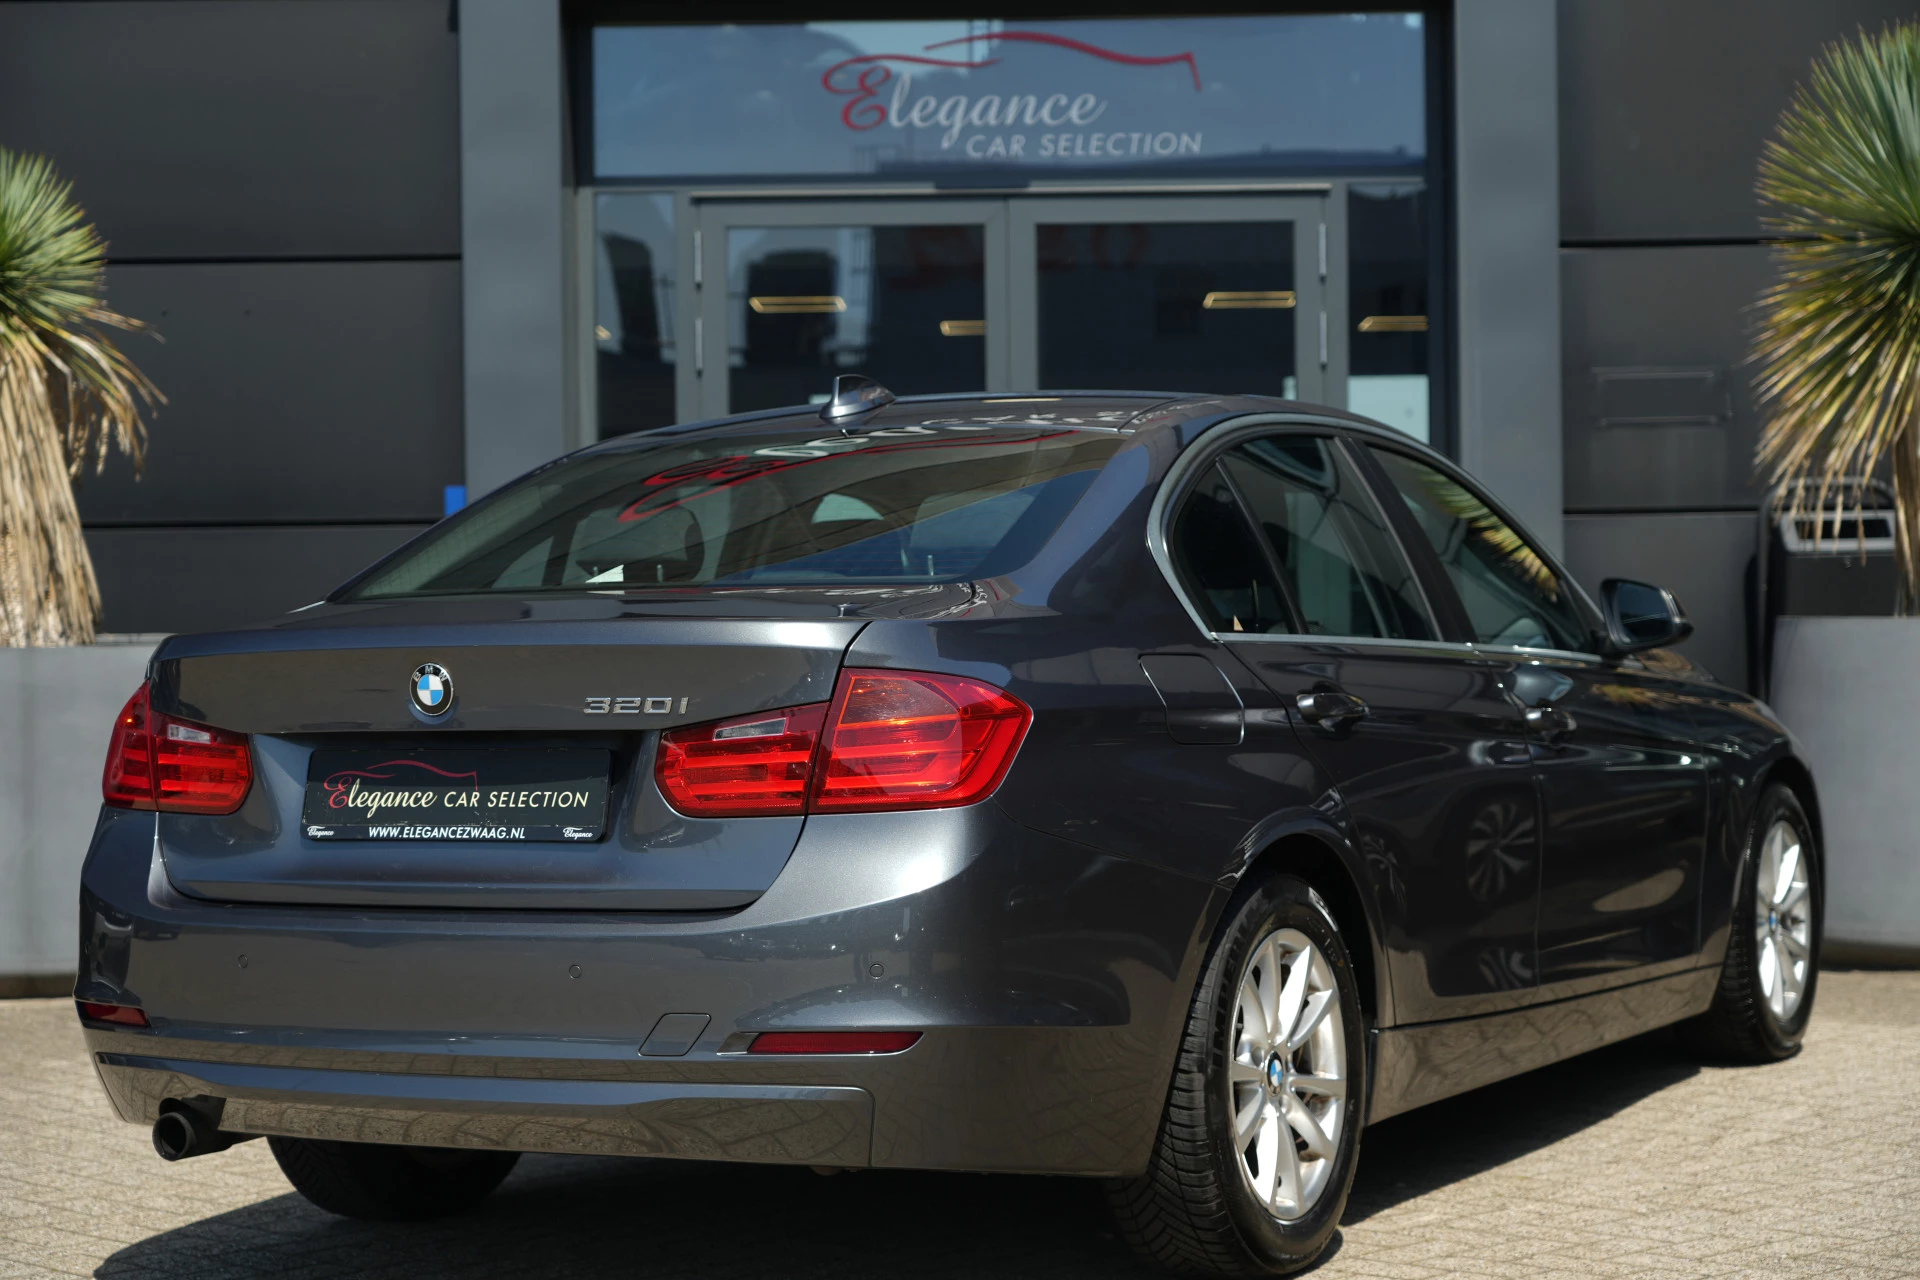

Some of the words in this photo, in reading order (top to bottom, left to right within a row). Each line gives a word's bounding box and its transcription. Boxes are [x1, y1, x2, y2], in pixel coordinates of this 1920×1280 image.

[822, 55, 1106, 150] Elegance
[966, 134, 1026, 158] CAR
[1039, 132, 1202, 157] SELECTION
[583, 697, 689, 714] 320i
[324, 770, 437, 818] Elegance
[444, 791, 480, 808] CAR
[487, 791, 590, 808] SELECTION
[368, 826, 527, 840] WWW.ELEGANCEZWAAG.NL
